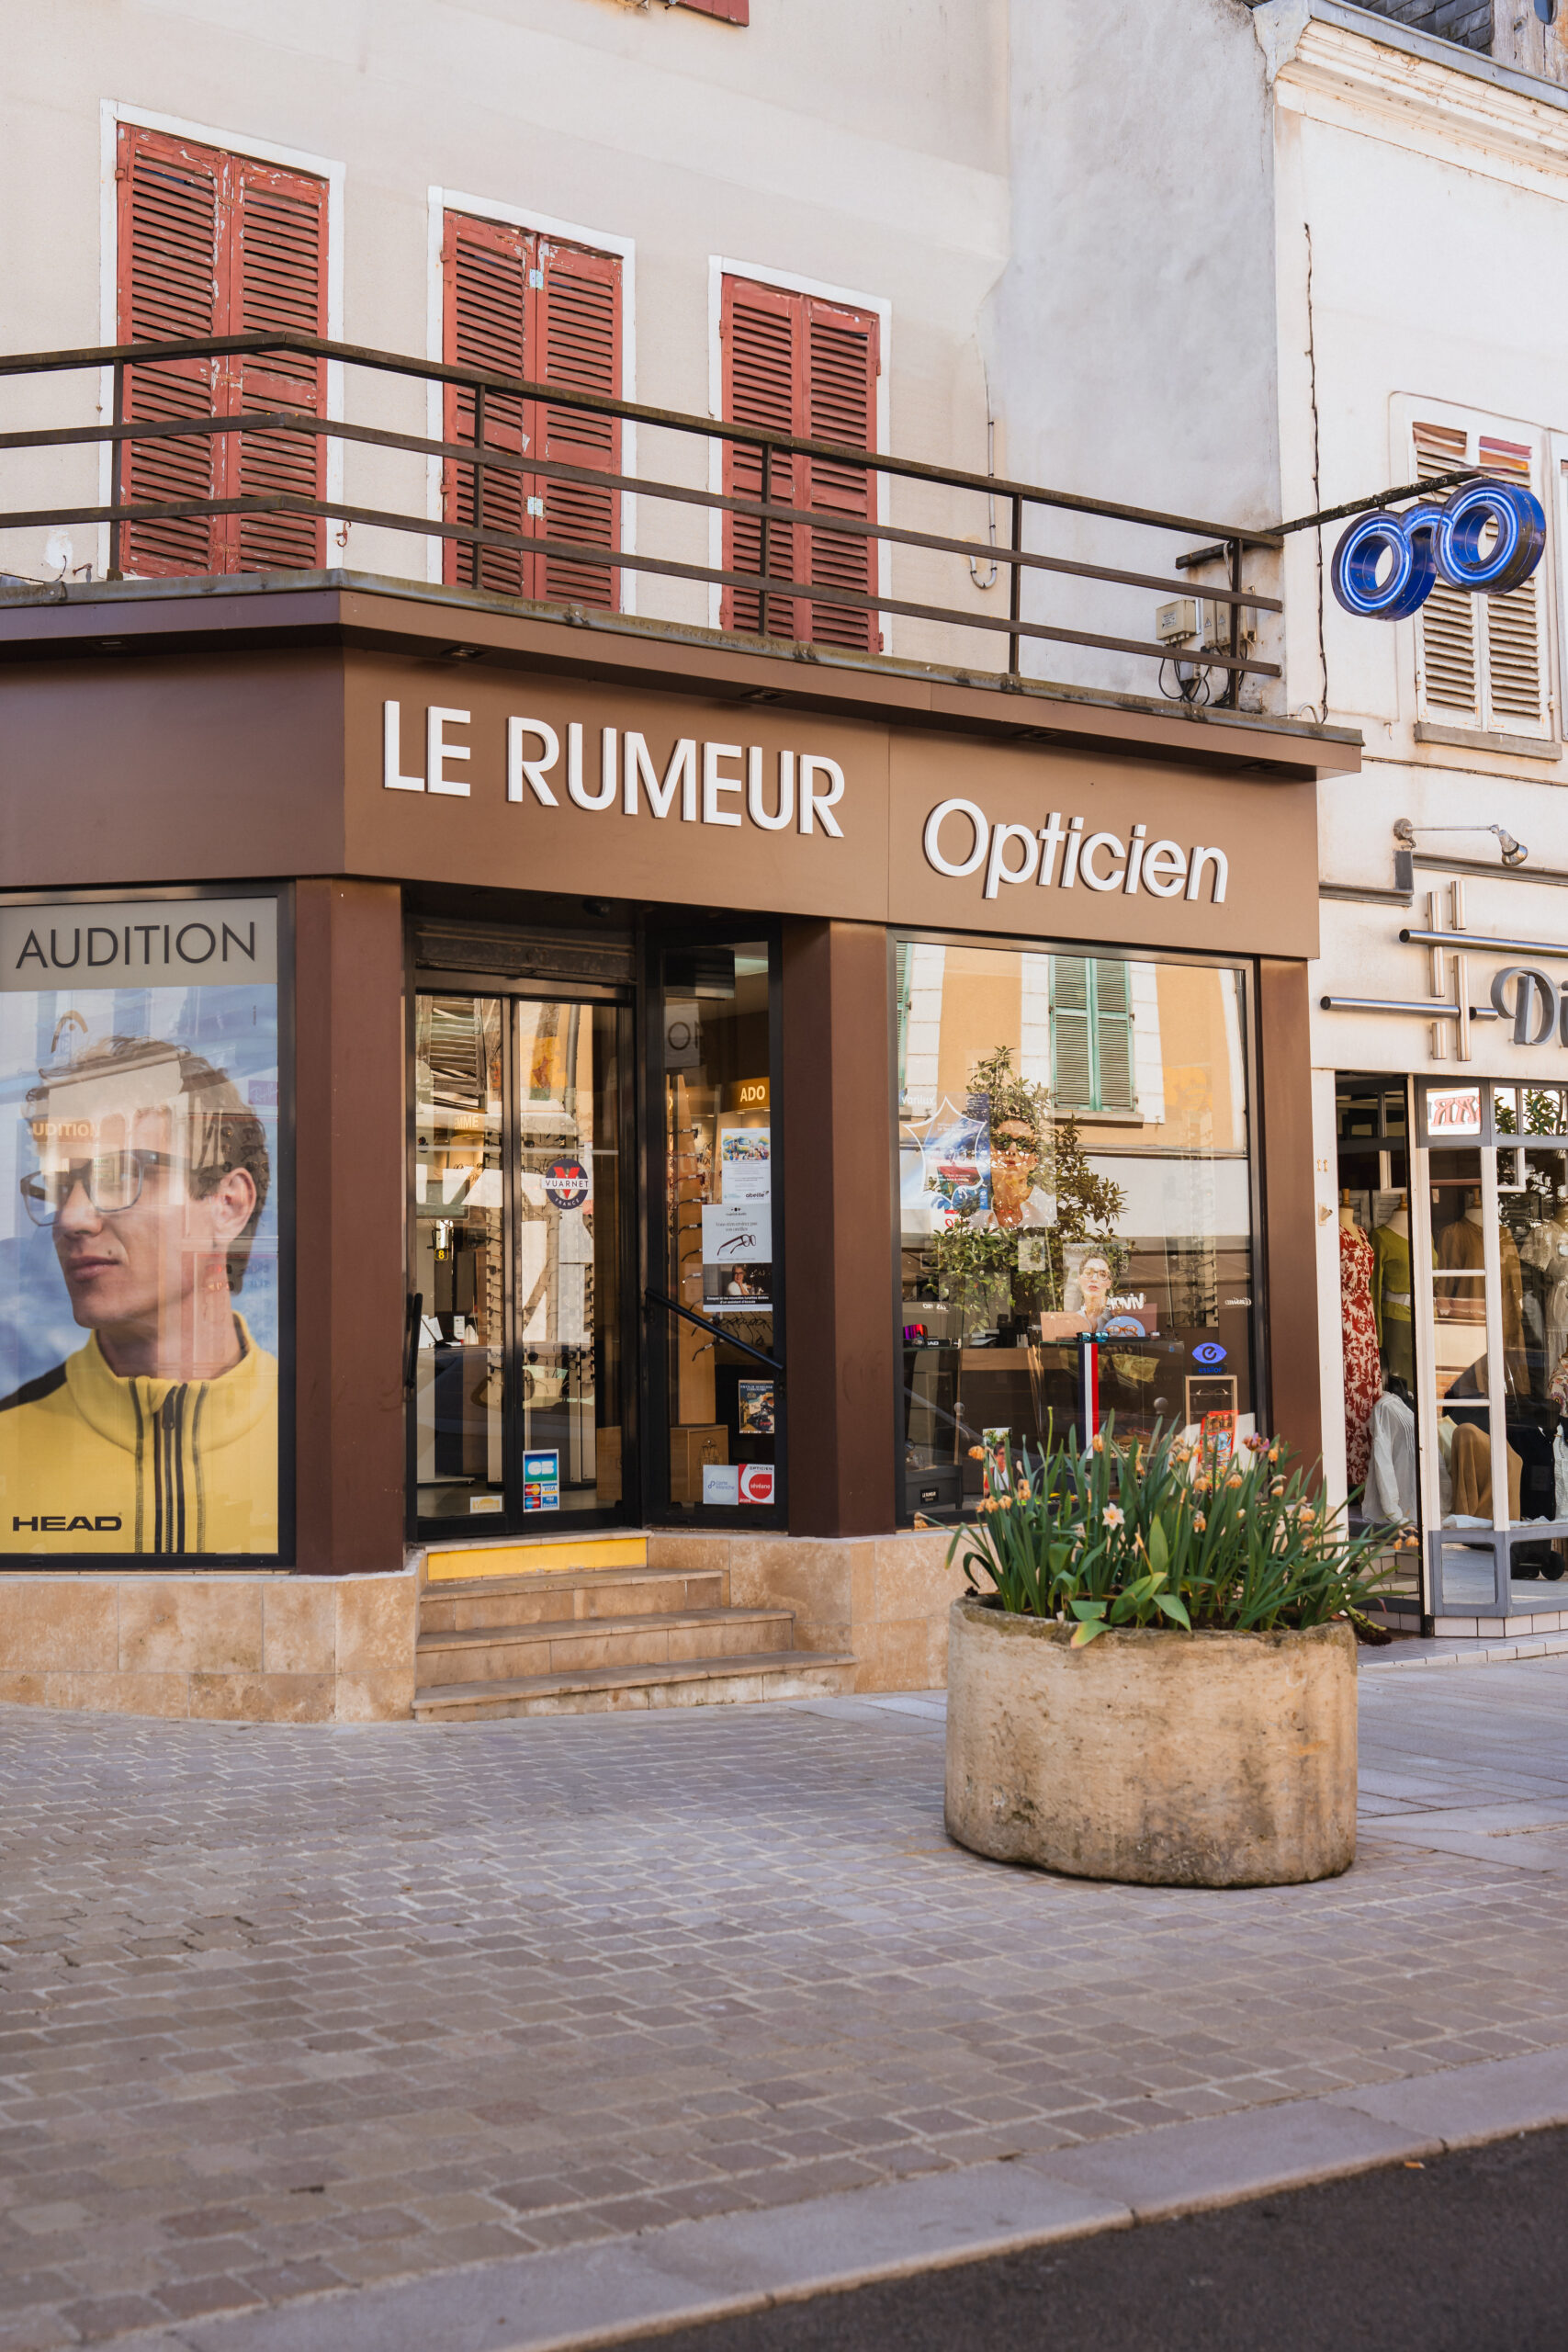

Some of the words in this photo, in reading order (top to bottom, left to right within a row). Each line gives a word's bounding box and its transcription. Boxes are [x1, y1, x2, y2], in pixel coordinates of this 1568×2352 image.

[384, 700, 470, 797] LE
[507, 716, 845, 837] RUMEUR
[924, 798, 1229, 903] Opticien
[16, 922, 256, 968] AUDITION
[739, 1085, 766, 1103] ADO
[1316, 1159, 1328, 1172] 11
[545, 1180, 590, 1188] VUARNET
[554, 1197, 581, 1207] FRANCE
[438, 1250, 445, 1260] 8
[527, 1461, 554, 1475] CB
[13, 1516, 122, 1532] HEAD
